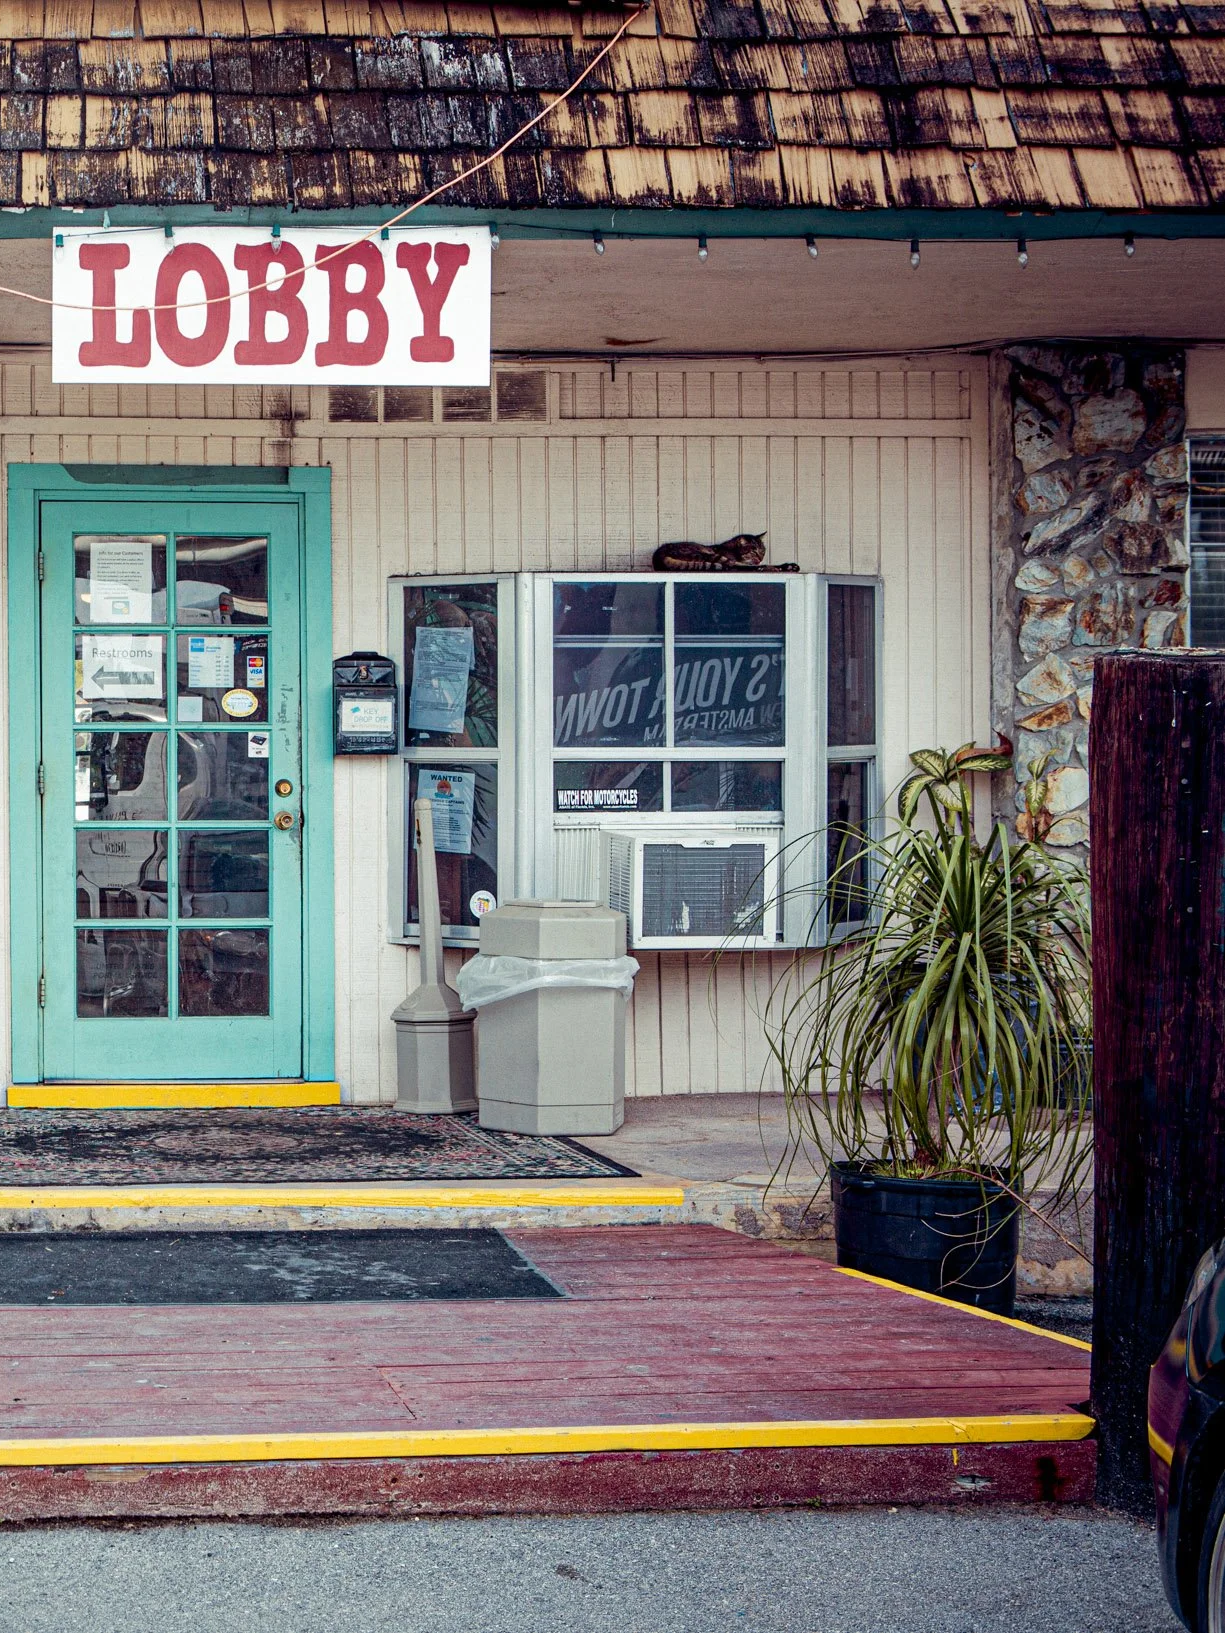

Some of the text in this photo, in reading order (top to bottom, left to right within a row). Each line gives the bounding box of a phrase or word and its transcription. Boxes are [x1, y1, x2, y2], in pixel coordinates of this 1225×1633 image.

[79, 242, 470, 367] LOBBY
[92, 648, 153, 658] Restrooms
[431, 774, 463, 782] WANTED
[558, 789, 638, 805] WATCH FOR MOTORCYCLES
